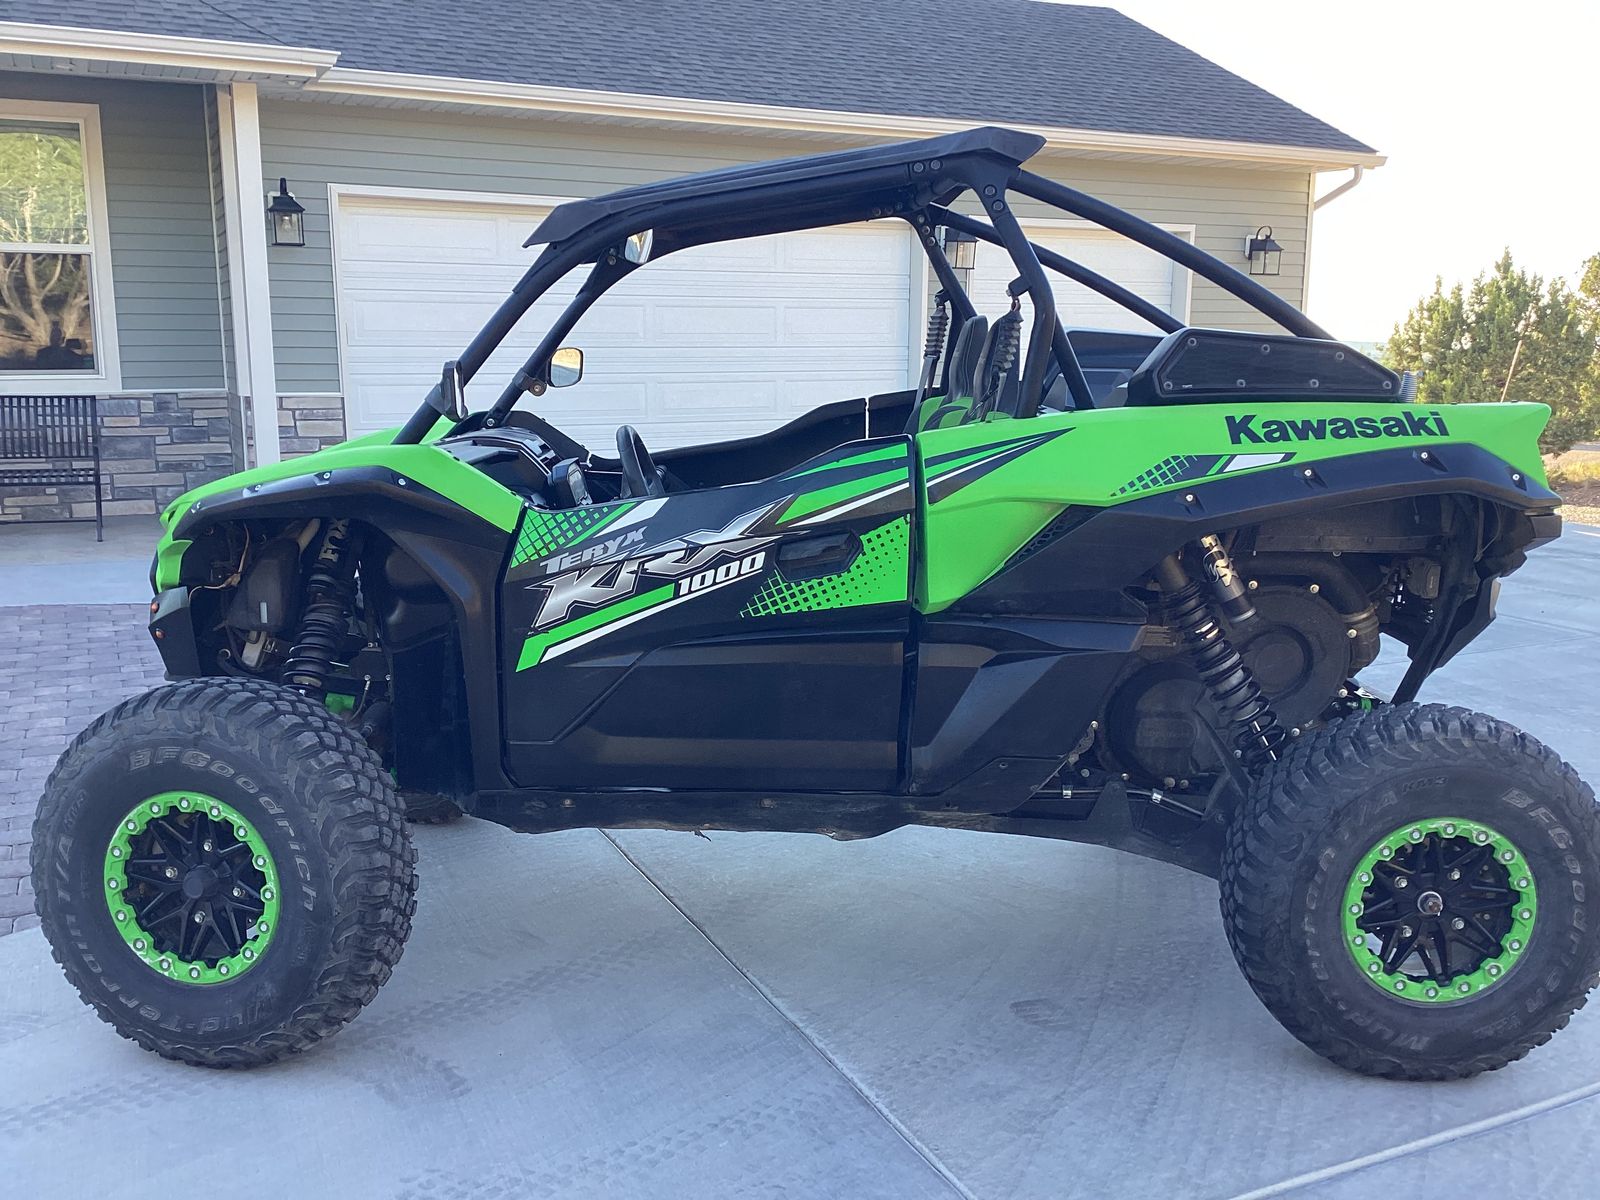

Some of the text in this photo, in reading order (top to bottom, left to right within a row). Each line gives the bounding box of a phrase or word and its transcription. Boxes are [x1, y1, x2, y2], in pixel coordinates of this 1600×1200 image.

[1225, 411, 1450, 444] Kawasaki
[524, 493, 805, 631] KRX
[678, 551, 767, 597] 1000
